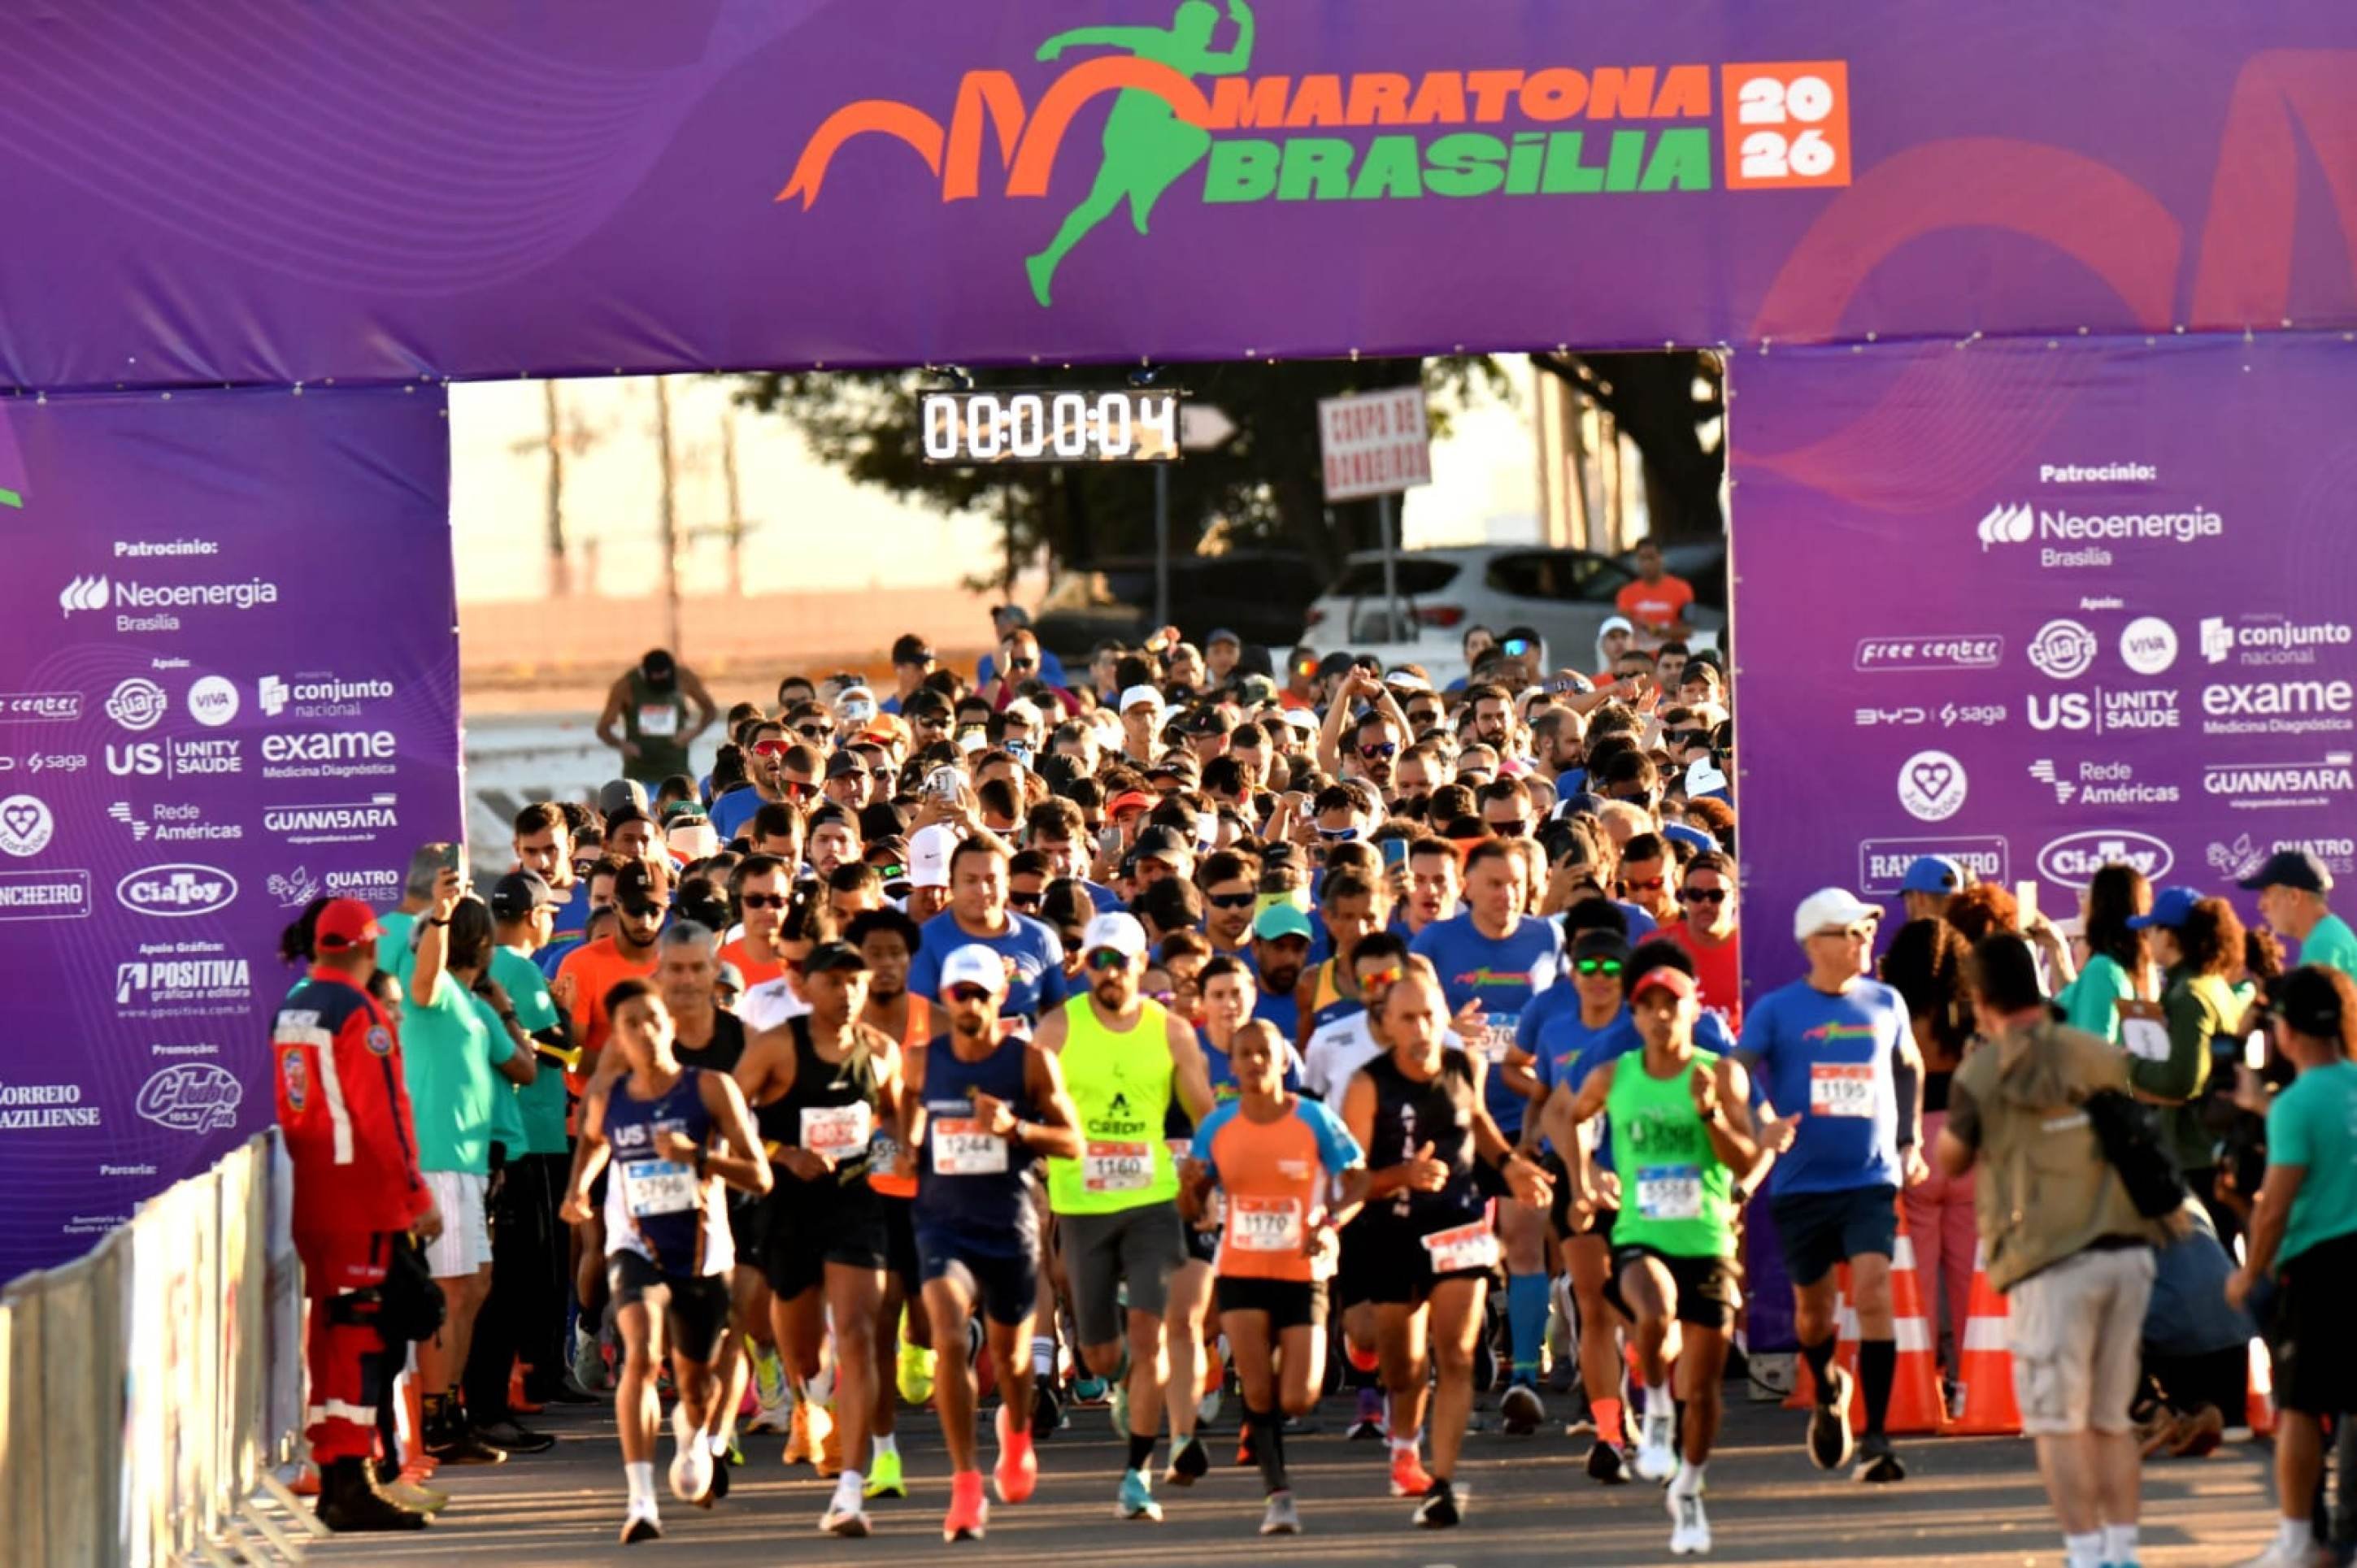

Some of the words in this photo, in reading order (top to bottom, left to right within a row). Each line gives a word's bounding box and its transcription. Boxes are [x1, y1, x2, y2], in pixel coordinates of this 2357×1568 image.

[1207, 64, 1711, 130] MARATONA
[1737, 76, 1835, 124] 20
[1739, 129, 1837, 179] 26
[2040, 462, 2156, 483] Patrocínio:
[2040, 506, 2223, 543] Neoenergia
[114, 538, 218, 558] Patrocínio:
[2041, 547, 2113, 567] Brasília
[115, 576, 277, 609] Neoenergia
[115, 613, 180, 632] Brasília
[2238, 621, 2352, 649] conjunto
[1861, 644, 1915, 664] free
[1921, 640, 1997, 664] center
[2240, 649, 2316, 666] nacional
[293, 678, 394, 703] conjunto
[2104, 689, 2178, 709] UNITY
[2202, 680, 2354, 715] exame
[294, 702, 362, 718] nacional
[1959, 705, 2007, 726] saga
[2027, 693, 2092, 731] US
[2203, 720, 2268, 734] Medicina
[174, 740, 241, 757] UNITY
[261, 730, 396, 762] exame
[45, 754, 88, 772] saga
[106, 742, 163, 775] US
[263, 766, 320, 778] Medicina
[2079, 761, 2133, 781] Rede
[2203, 769, 2354, 794] GUANABARA
[2081, 783, 2180, 804] Américas
[153, 803, 200, 820] Rede
[264, 809, 398, 832] GUANABARA
[154, 822, 242, 840] Américas
[325, 870, 398, 889] QUATRO
[150, 958, 250, 989] POSITIVA
[0, 1081, 80, 1105] ORREIO
[1095, 1158, 1142, 1176] 1160
